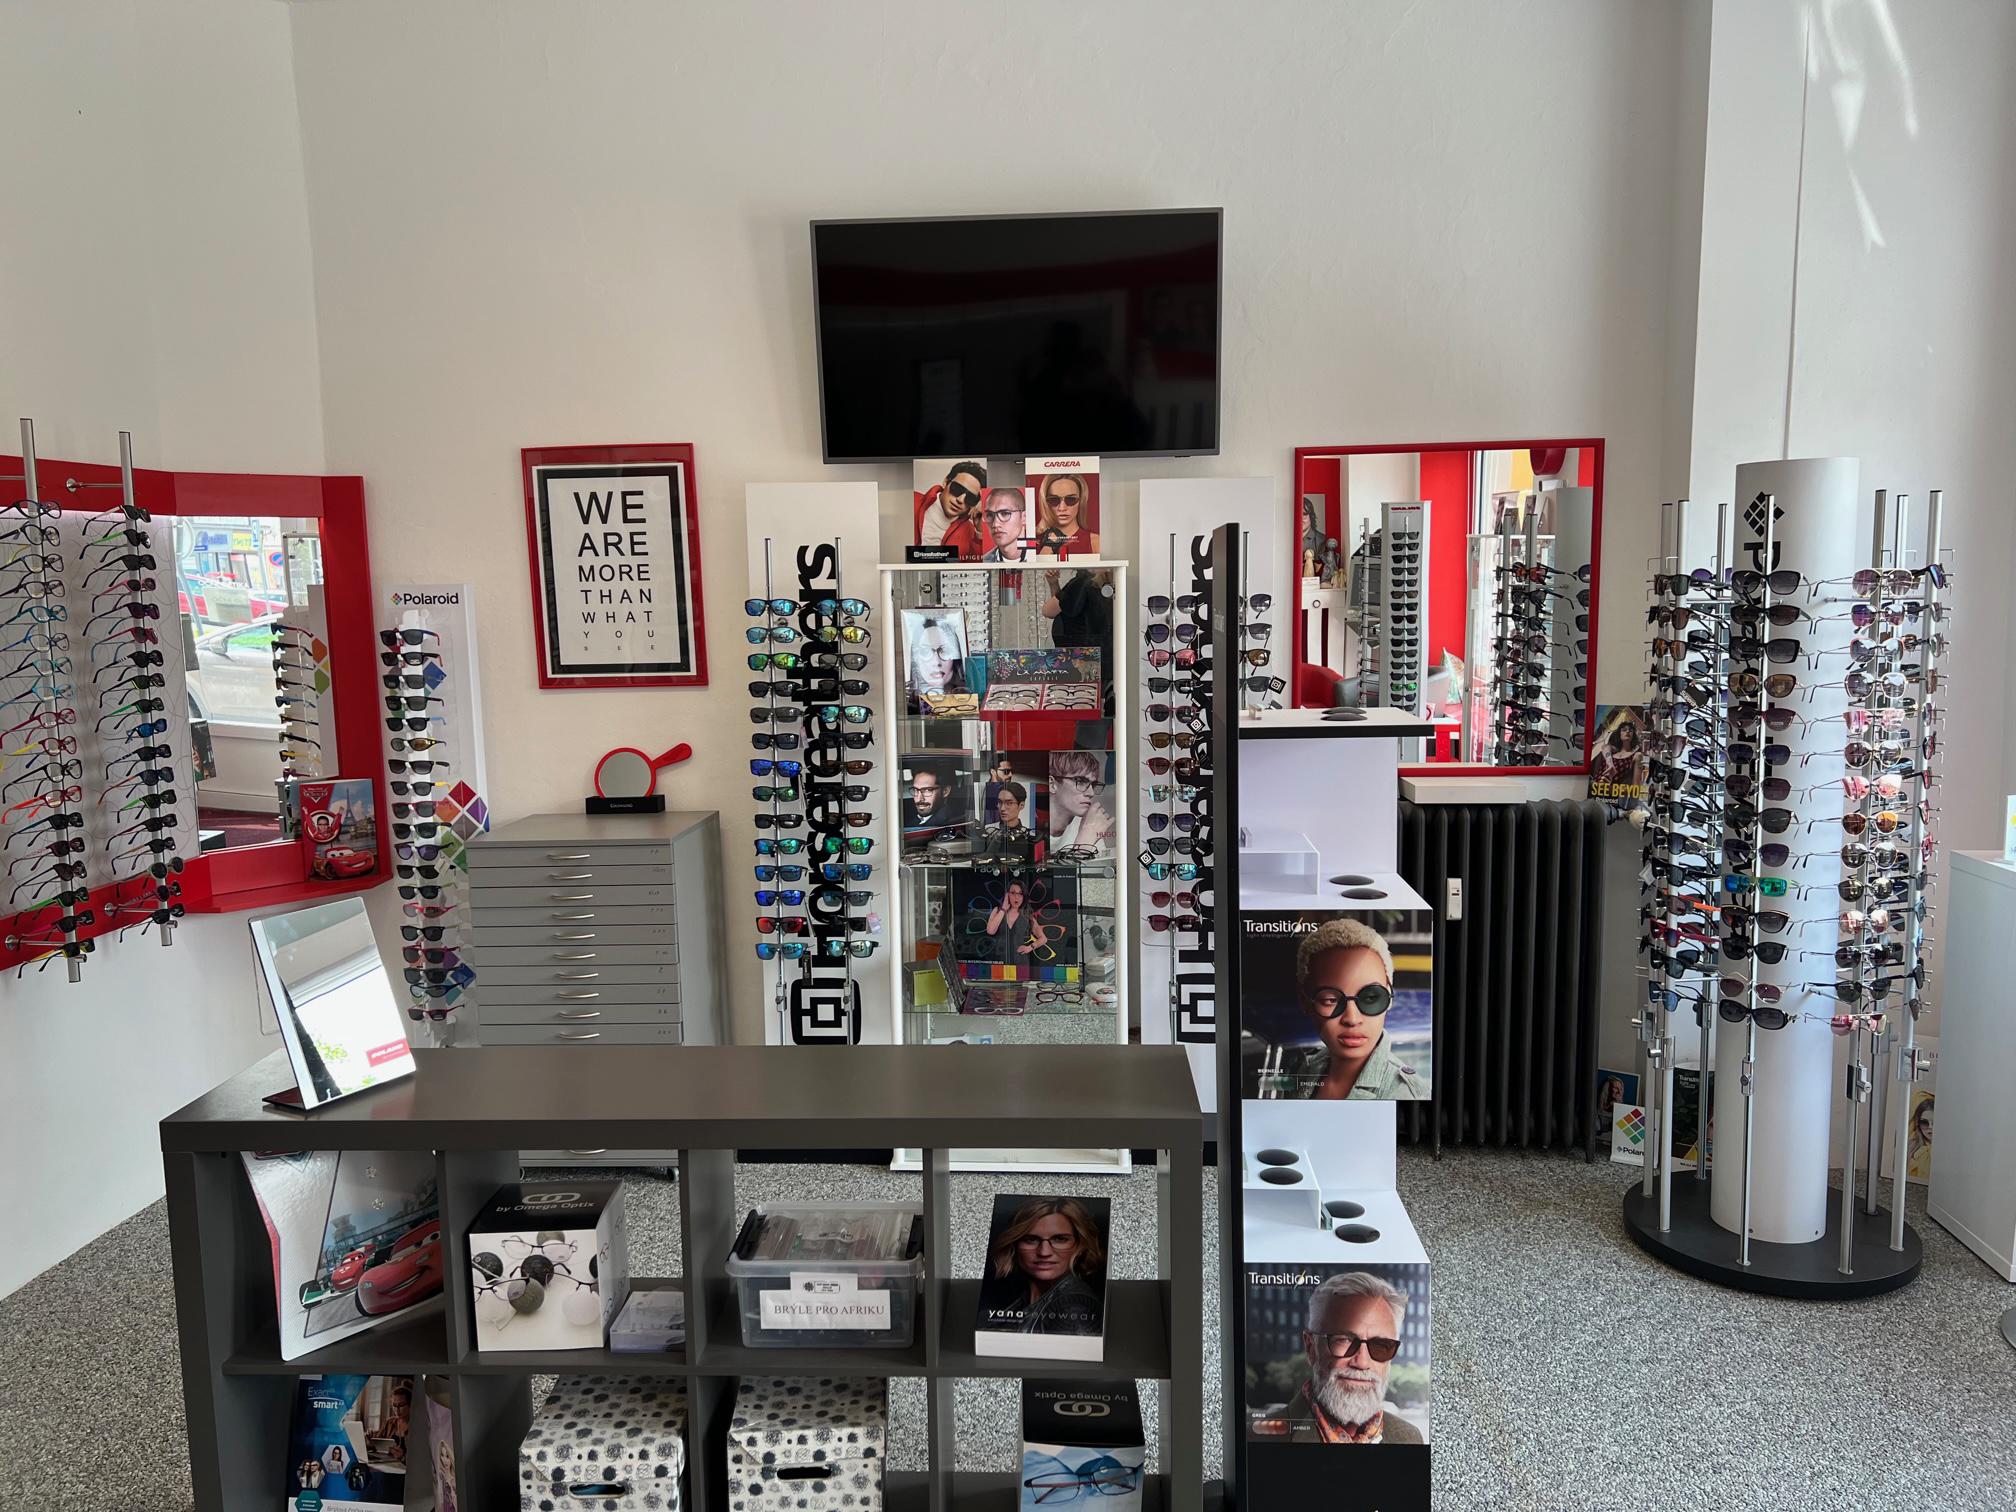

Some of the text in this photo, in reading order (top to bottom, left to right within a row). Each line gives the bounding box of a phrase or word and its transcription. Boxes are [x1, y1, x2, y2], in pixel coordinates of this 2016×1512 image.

[573, 490, 647, 525] WE
[578, 531, 649, 557] ARE
[578, 563, 651, 582] MORE
[403, 592, 459, 605] Polaroid
[580, 588, 652, 604] THAN
[582, 610, 653, 623] WHAT
[583, 630, 655, 639] YOU
[1591, 782, 1648, 799] SEE BEYO
[1243, 918, 1319, 936] Transitions
[514, 1203, 557, 1211] Omega
[1248, 1271, 1321, 1288] Transitions
[774, 1303, 885, 1315] BRÝLE PRO AFRIKU
[988, 1309, 1024, 1318] yana
[1031, 1311, 1096, 1321] eyewear
[1034, 1391, 1128, 1403] by Omega Optix
[313, 1400, 338, 1409] smart
